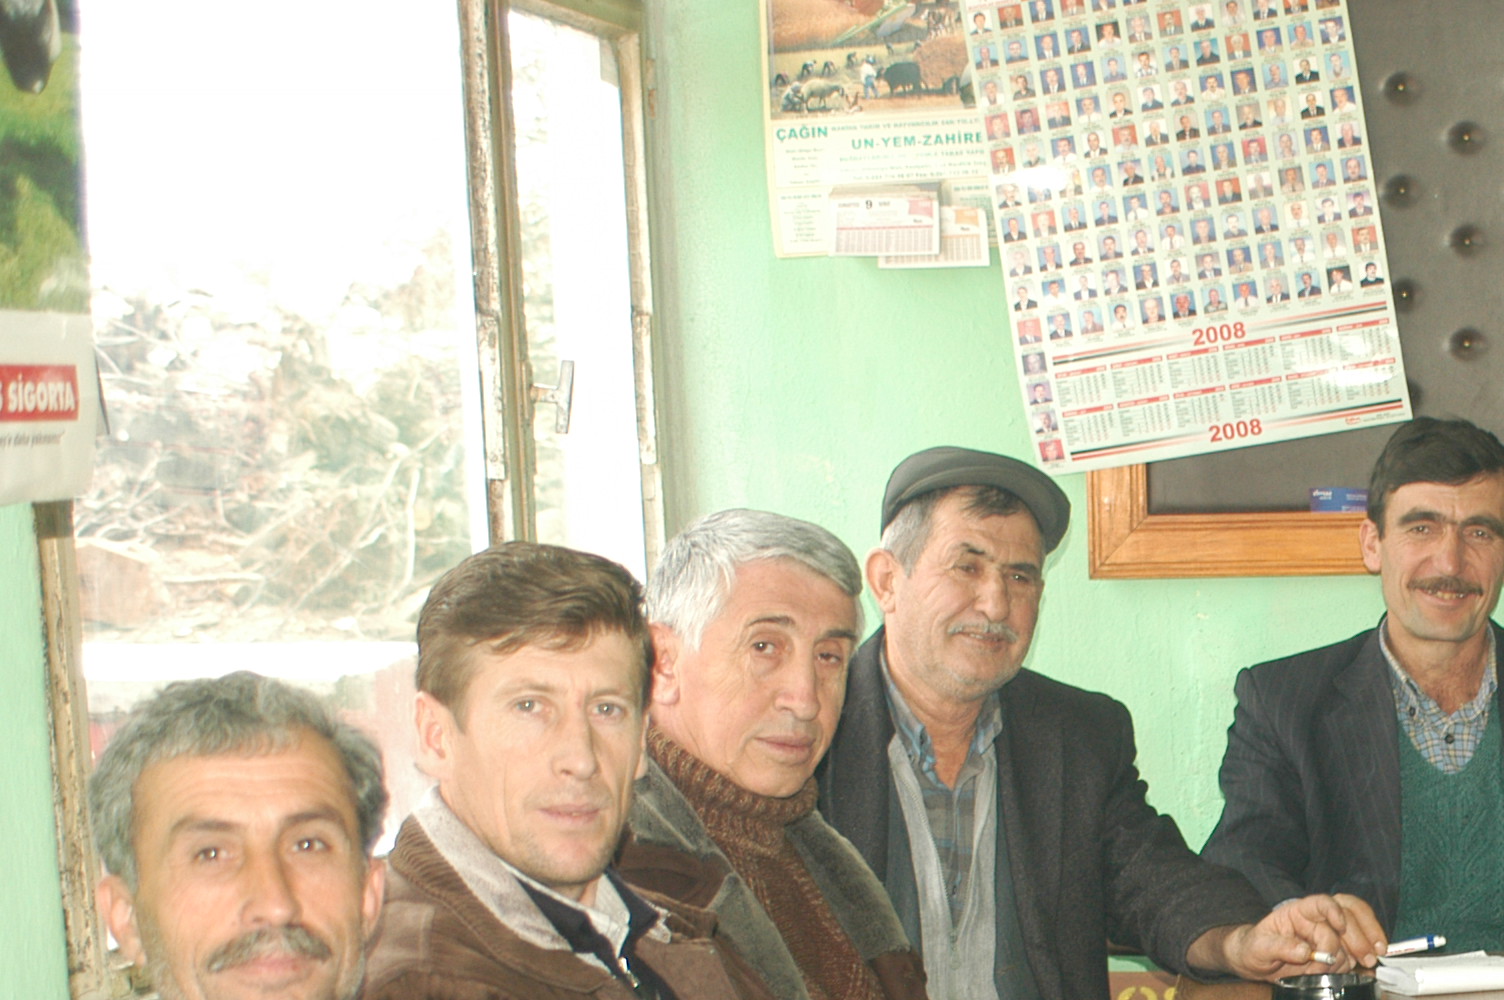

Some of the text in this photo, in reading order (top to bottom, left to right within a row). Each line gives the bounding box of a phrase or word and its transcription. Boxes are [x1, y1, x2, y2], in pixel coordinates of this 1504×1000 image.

[776, 124, 828, 142] ÇAĞIN
[851, 131, 983, 150] UN-YEM-ZAHİRE
[865, 200, 873, 209] 9
[1192, 322, 1246, 346] 2008
[8, 372, 76, 412] SİGORTA
[1208, 418, 1262, 443] 2008
